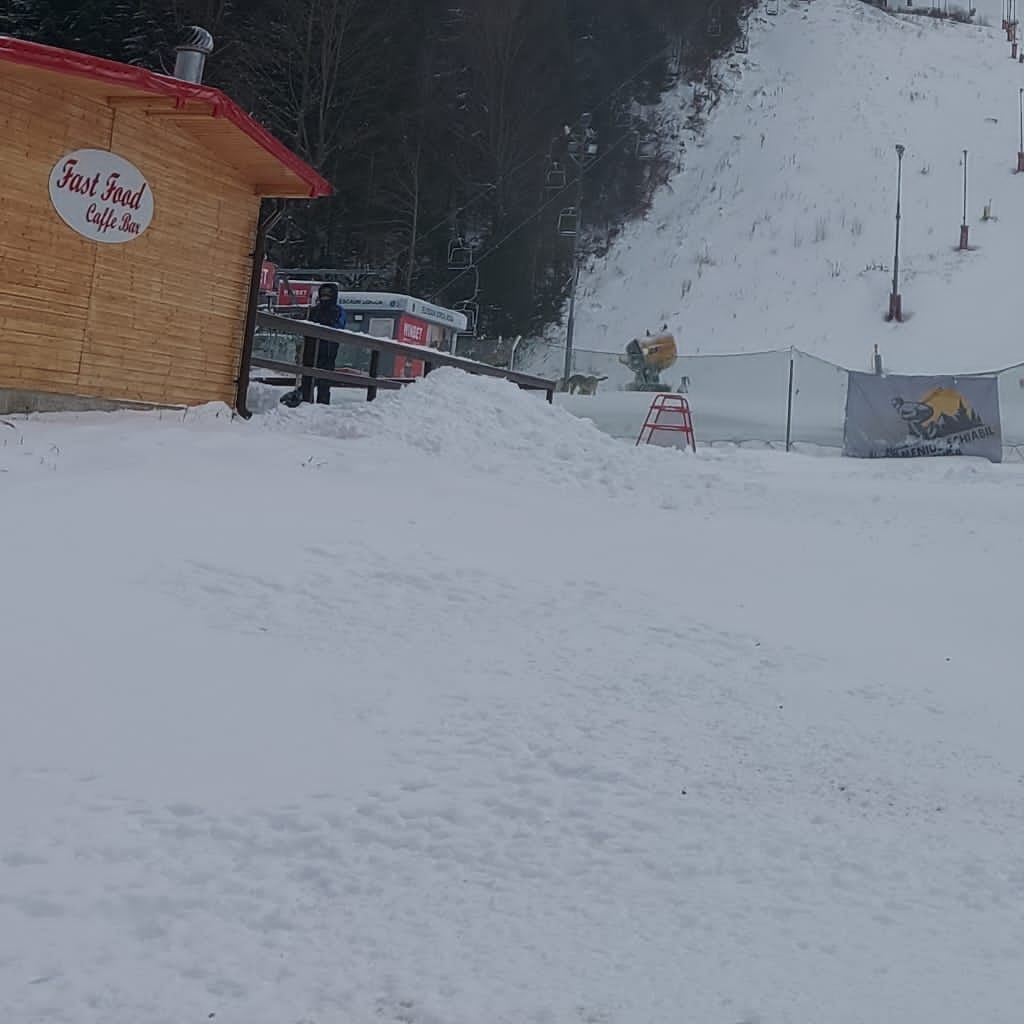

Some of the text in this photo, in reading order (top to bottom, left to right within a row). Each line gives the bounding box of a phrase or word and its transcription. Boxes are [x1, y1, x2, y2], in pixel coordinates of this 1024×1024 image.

[56, 159, 147, 210] Fast Food
[86, 203, 141, 234] Caffe Bar
